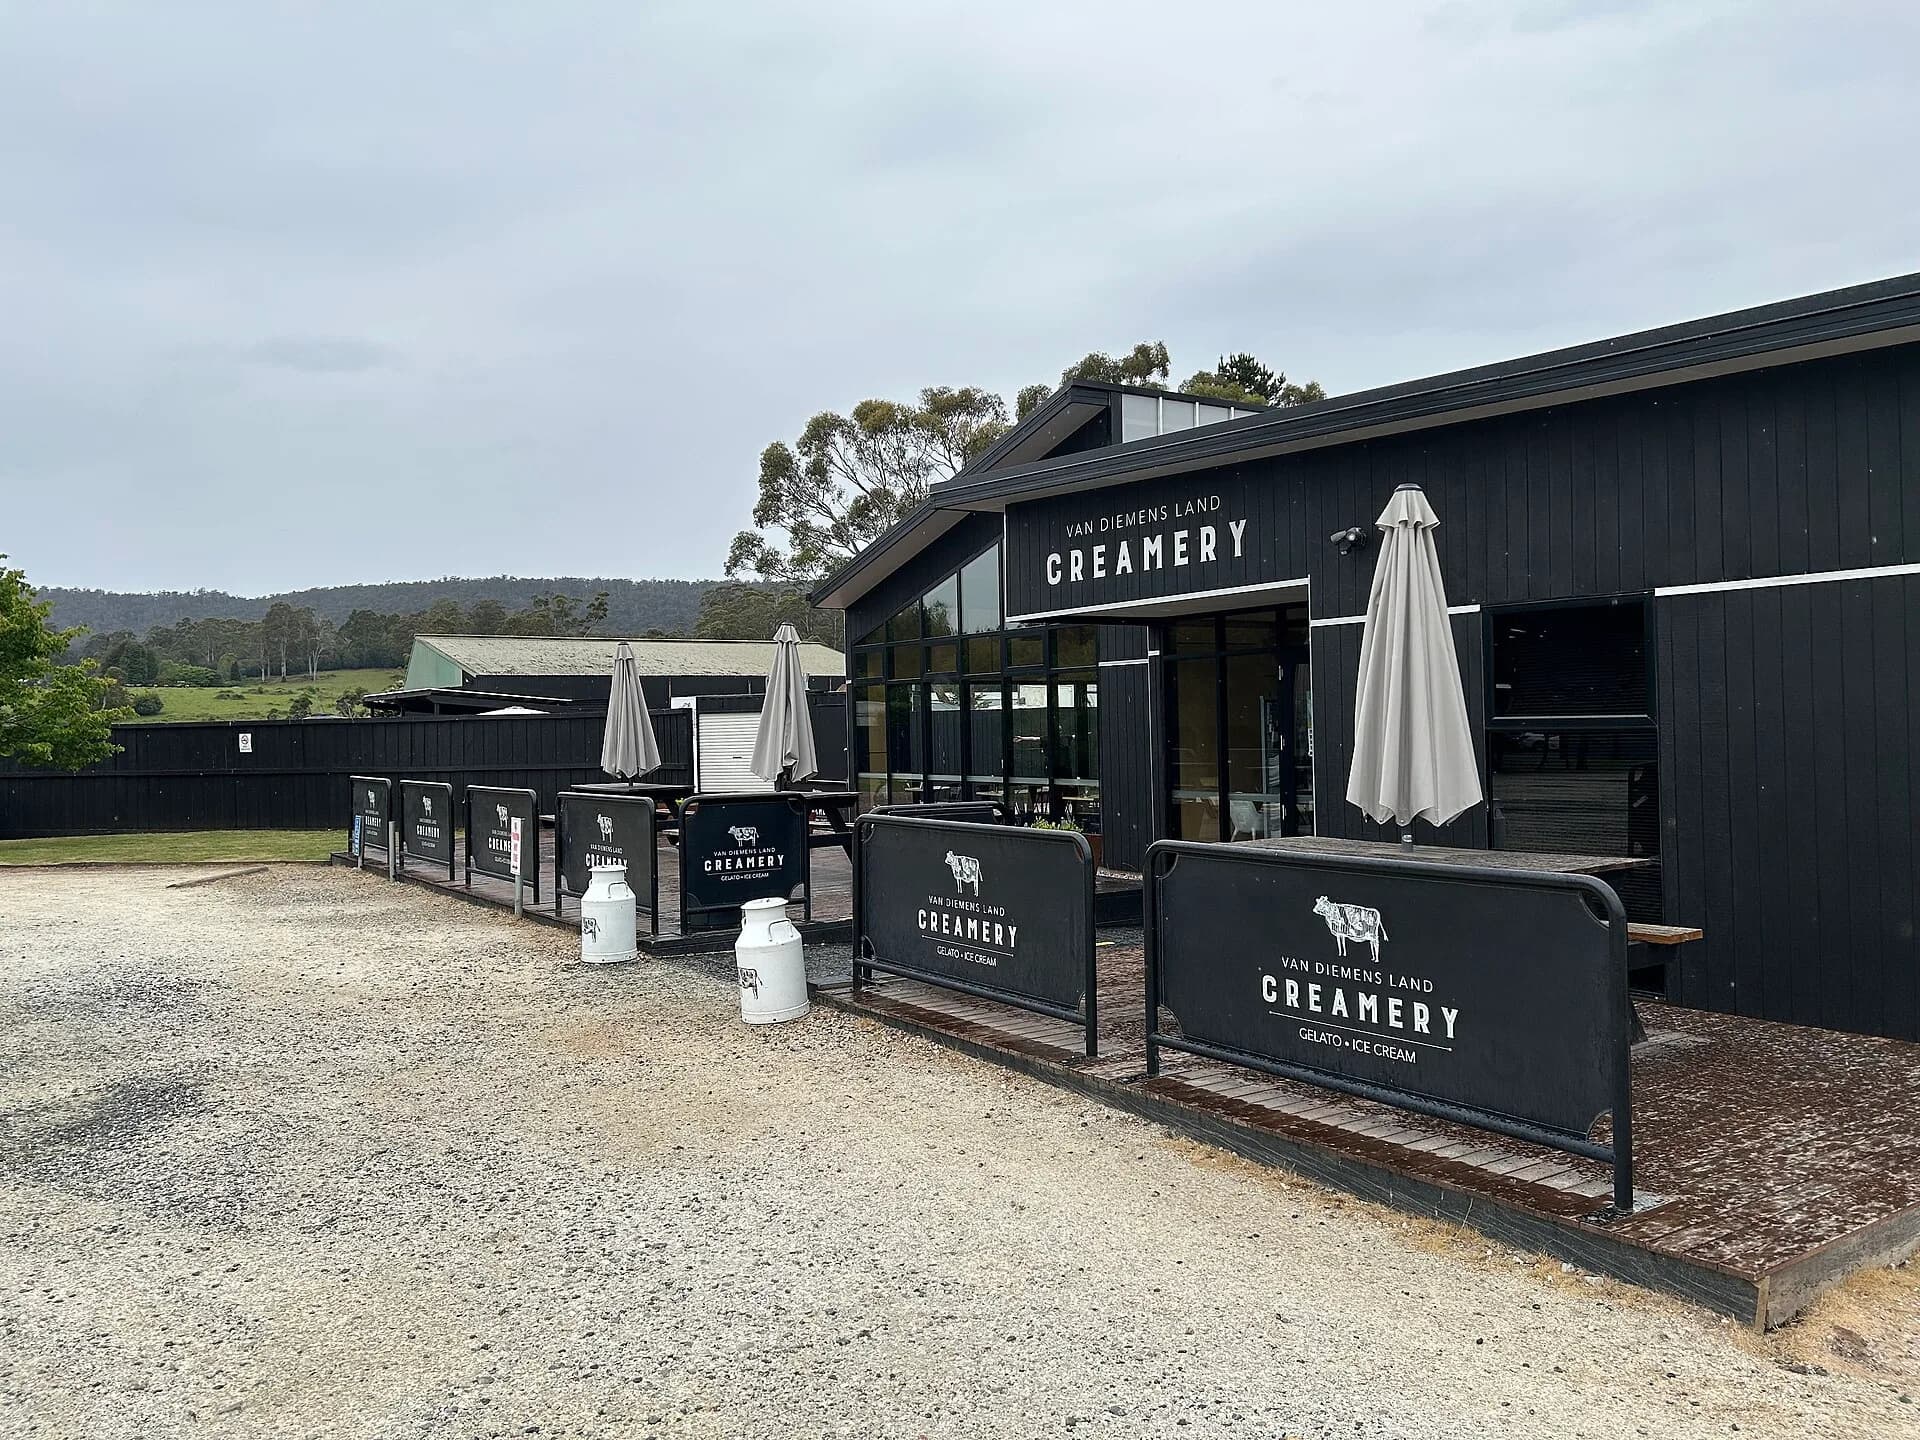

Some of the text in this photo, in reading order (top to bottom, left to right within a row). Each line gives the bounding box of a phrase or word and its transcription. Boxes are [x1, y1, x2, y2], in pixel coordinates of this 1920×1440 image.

[1066, 495, 1222, 538] VAN DIEMENS LAND
[1046, 519, 1248, 586] CREAMERY
[704, 854, 784, 871] CREAMERY
[728, 848, 757, 856] DIEMENS
[928, 895, 1005, 917] VAN DIEMENS LAND
[918, 909, 1017, 948] CREAMERY
[936, 945, 997, 967] GELATO ICE CREAM
[1281, 955, 1434, 993] VAN DIEMENS LAND
[1262, 974, 1459, 1039] CREAMERY
[1299, 1027, 1416, 1064] GELATO ICE CREAM
